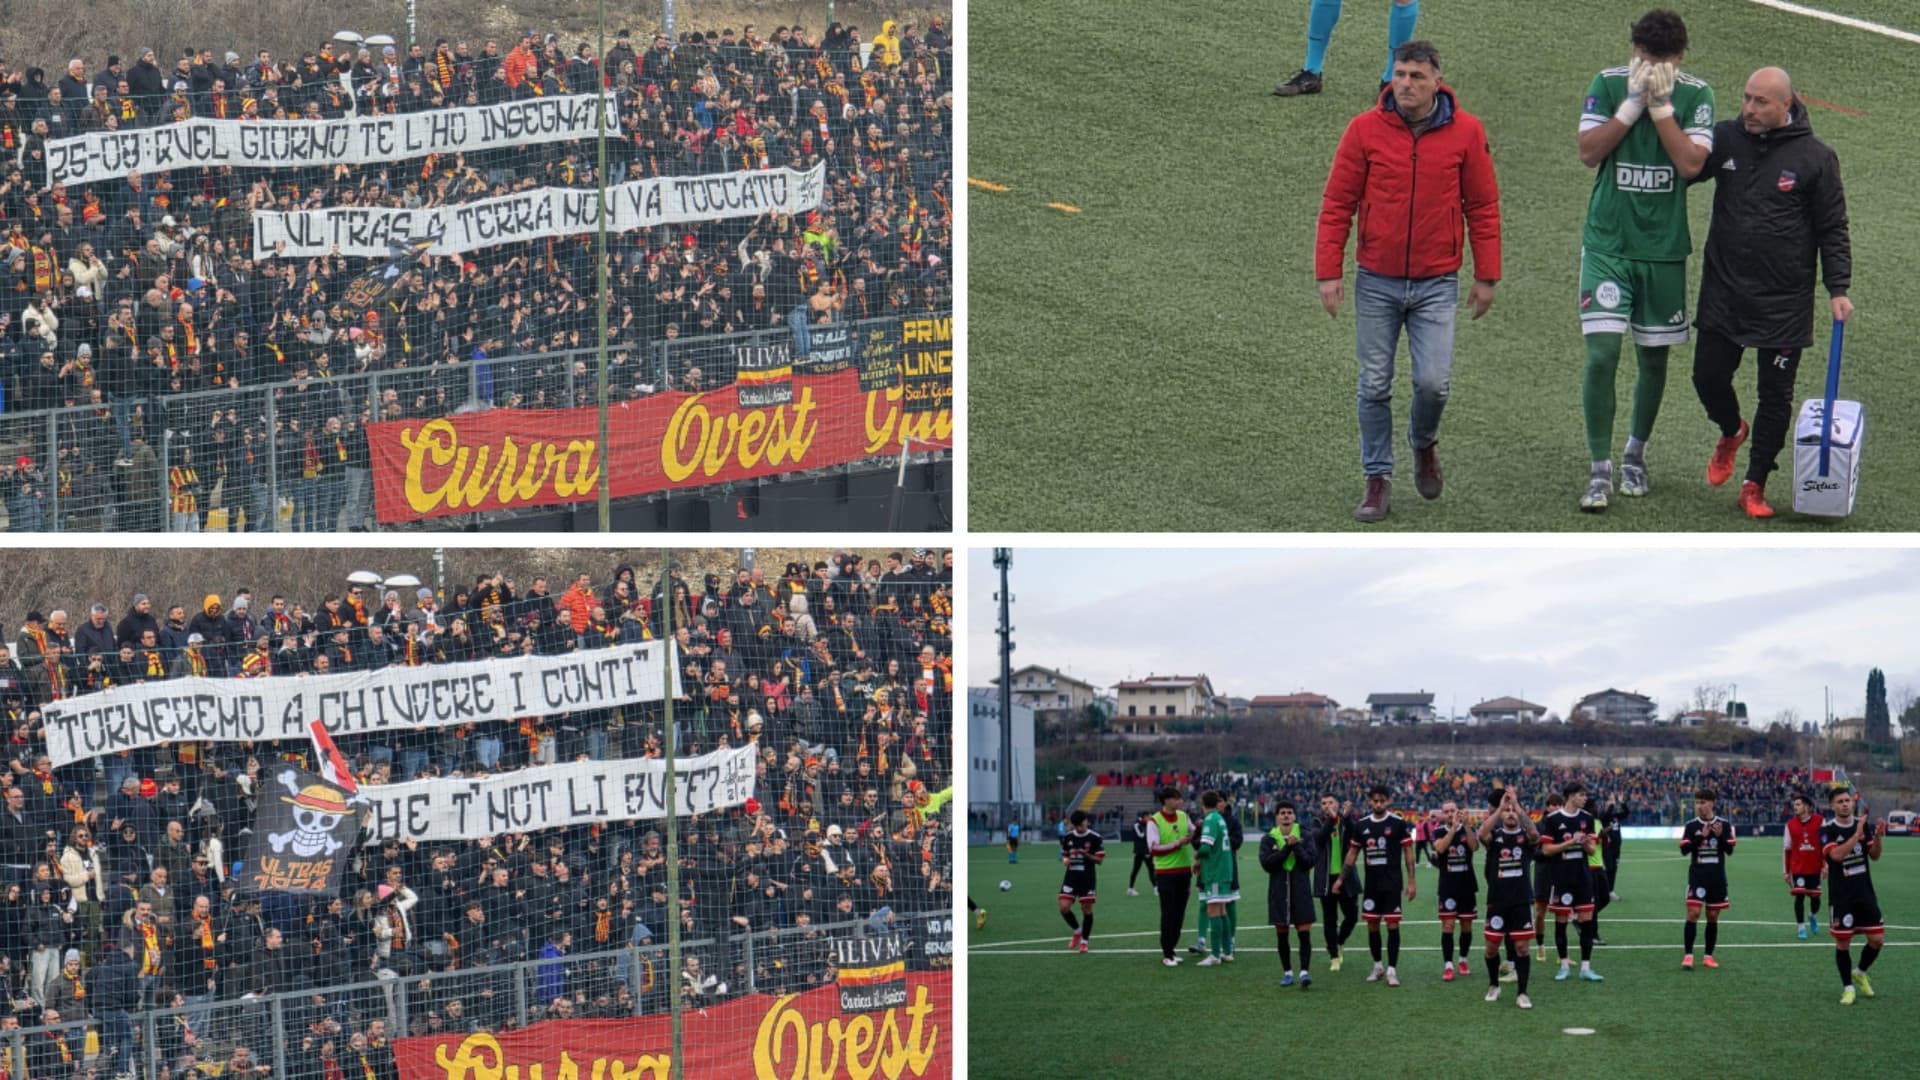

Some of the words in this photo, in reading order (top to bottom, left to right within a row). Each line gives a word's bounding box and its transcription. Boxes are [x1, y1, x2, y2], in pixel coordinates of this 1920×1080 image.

[240, 124, 349, 160] GIORNO
[360, 121, 393, 157] TE
[406, 111, 467, 151] L'HO
[479, 97, 618, 142] INSEGNATO
[1617, 168, 1670, 187] DMP
[428, 212, 447, 246] A
[457, 194, 553, 243] TERRA
[563, 190, 617, 227] NON
[628, 183, 662, 218] VA
[675, 174, 788, 214] TOCCATO
[904, 350, 952, 377] LINE
[1774, 355, 1789, 369] FC
[401, 418, 599, 513] Curva
[661, 385, 818, 484] Ovest
[282, 693, 304, 734] A
[513, 671, 527, 712] I
[367, 793, 430, 840] HE
[568, 774, 608, 816] LI
